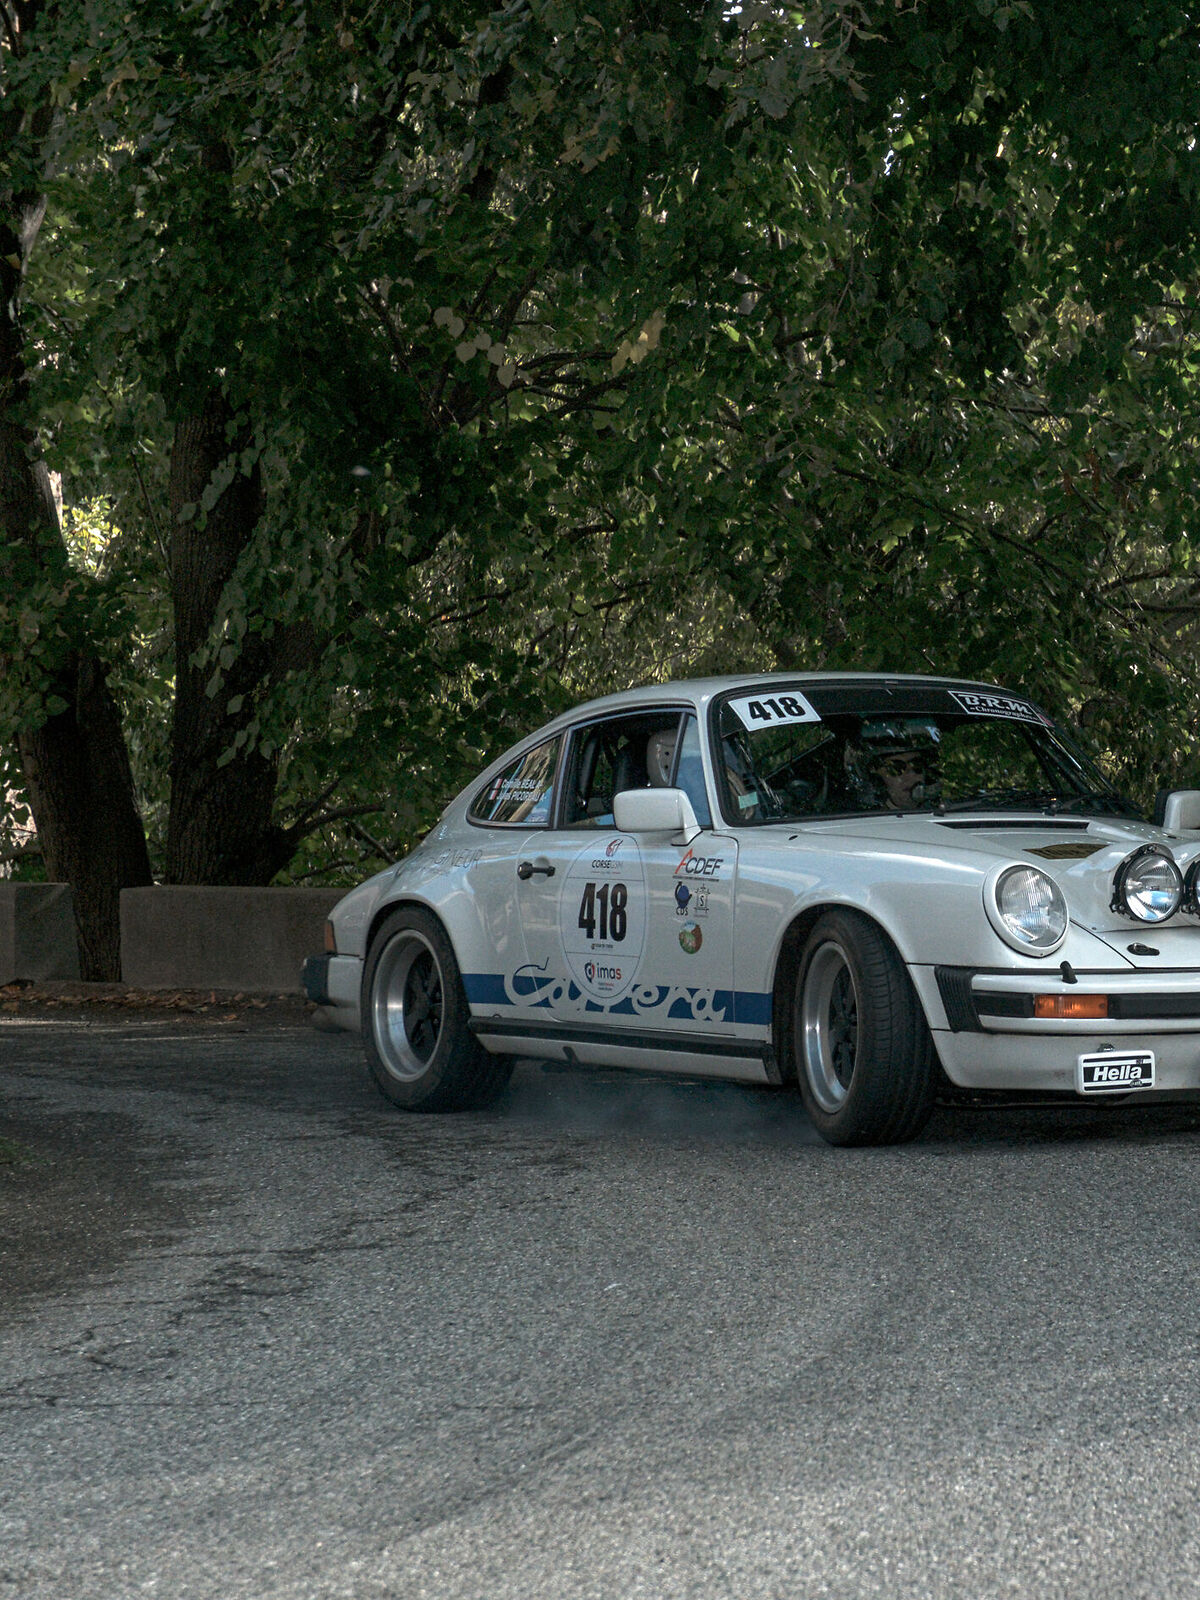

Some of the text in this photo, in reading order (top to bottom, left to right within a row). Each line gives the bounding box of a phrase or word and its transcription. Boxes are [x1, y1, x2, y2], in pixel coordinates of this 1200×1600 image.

[747, 696, 806, 721] 418
[578, 882, 628, 942] 418
[597, 962, 622, 981] imas
[504, 956, 727, 1023] Caera
[1092, 1064, 1143, 1082] Hella
